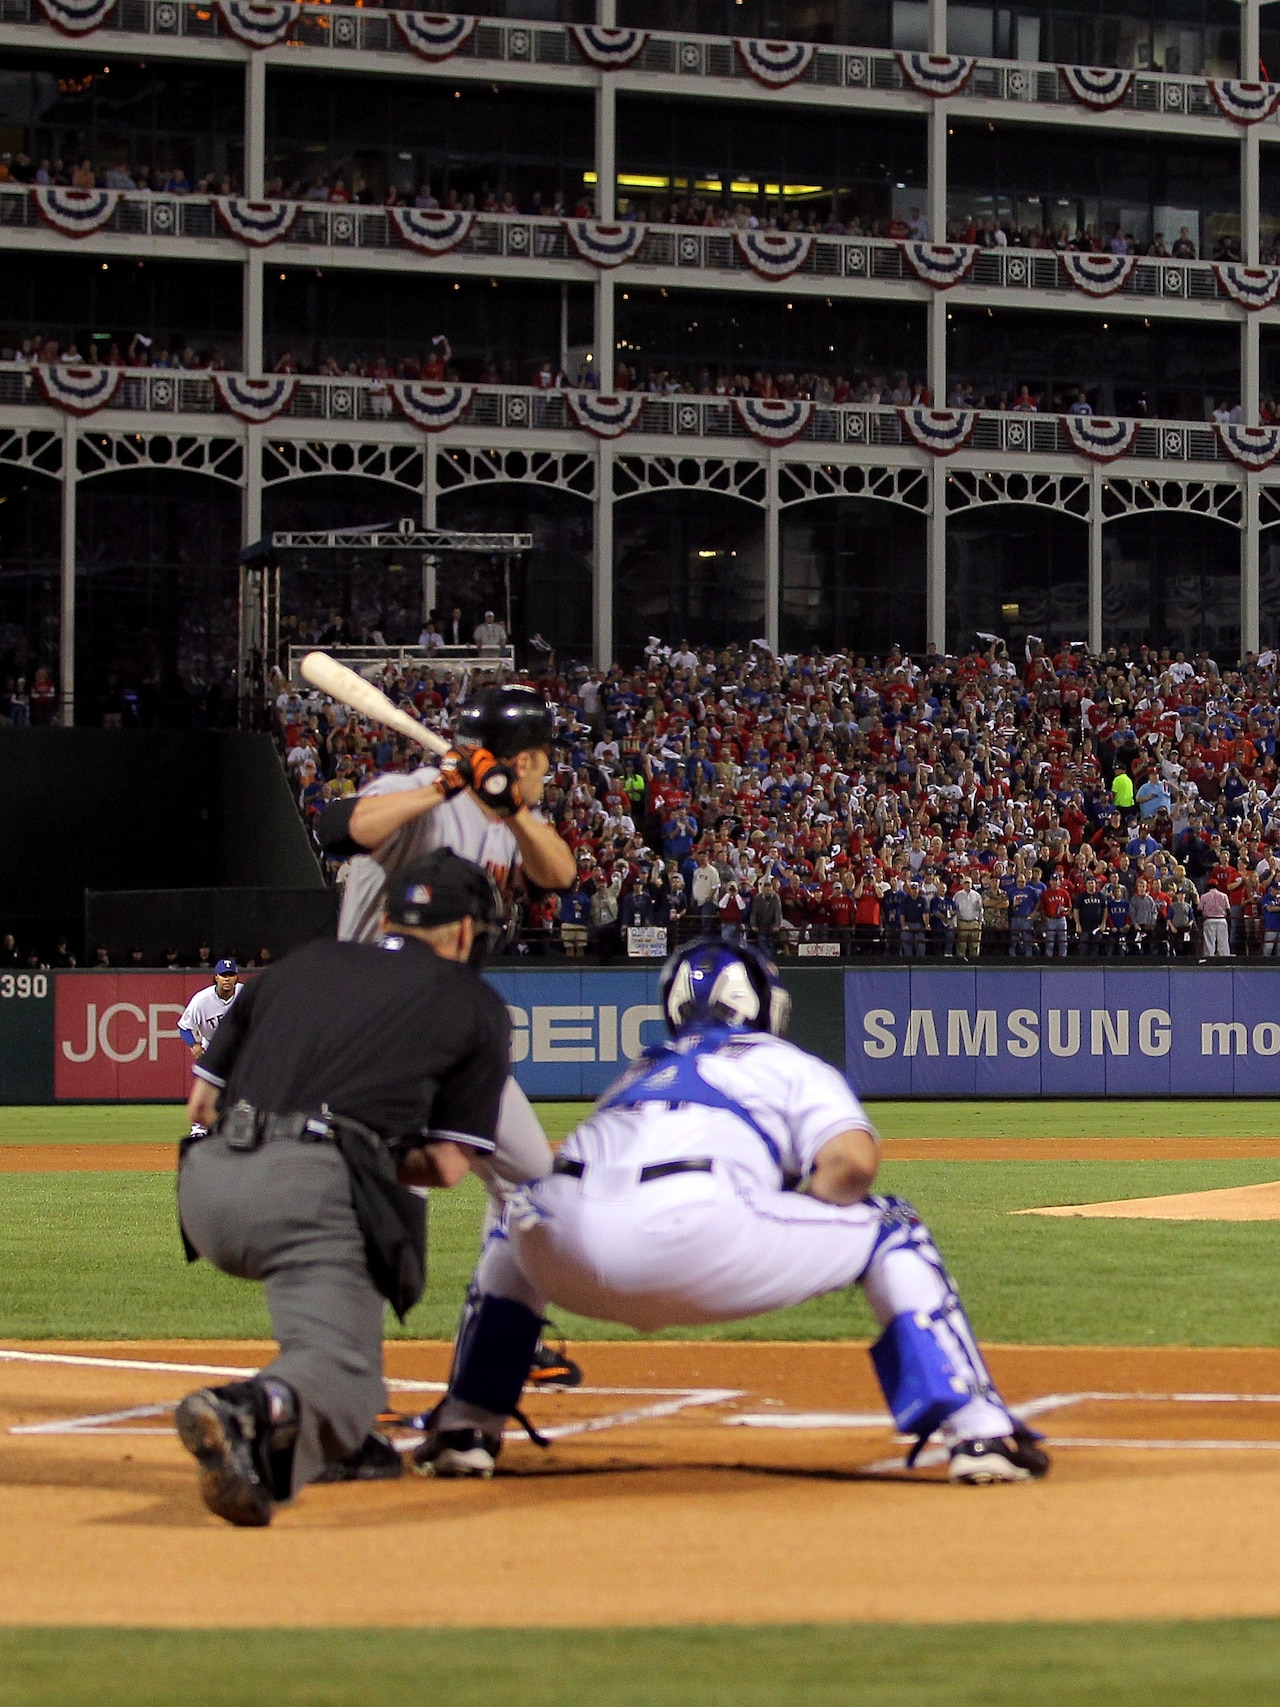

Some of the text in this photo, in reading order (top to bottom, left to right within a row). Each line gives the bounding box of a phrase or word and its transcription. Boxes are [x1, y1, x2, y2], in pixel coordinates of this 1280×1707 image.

[223, 960, 232, 968] T
[1, 974, 48, 999] 390
[863, 1008, 1172, 1059] SAMSUNG
